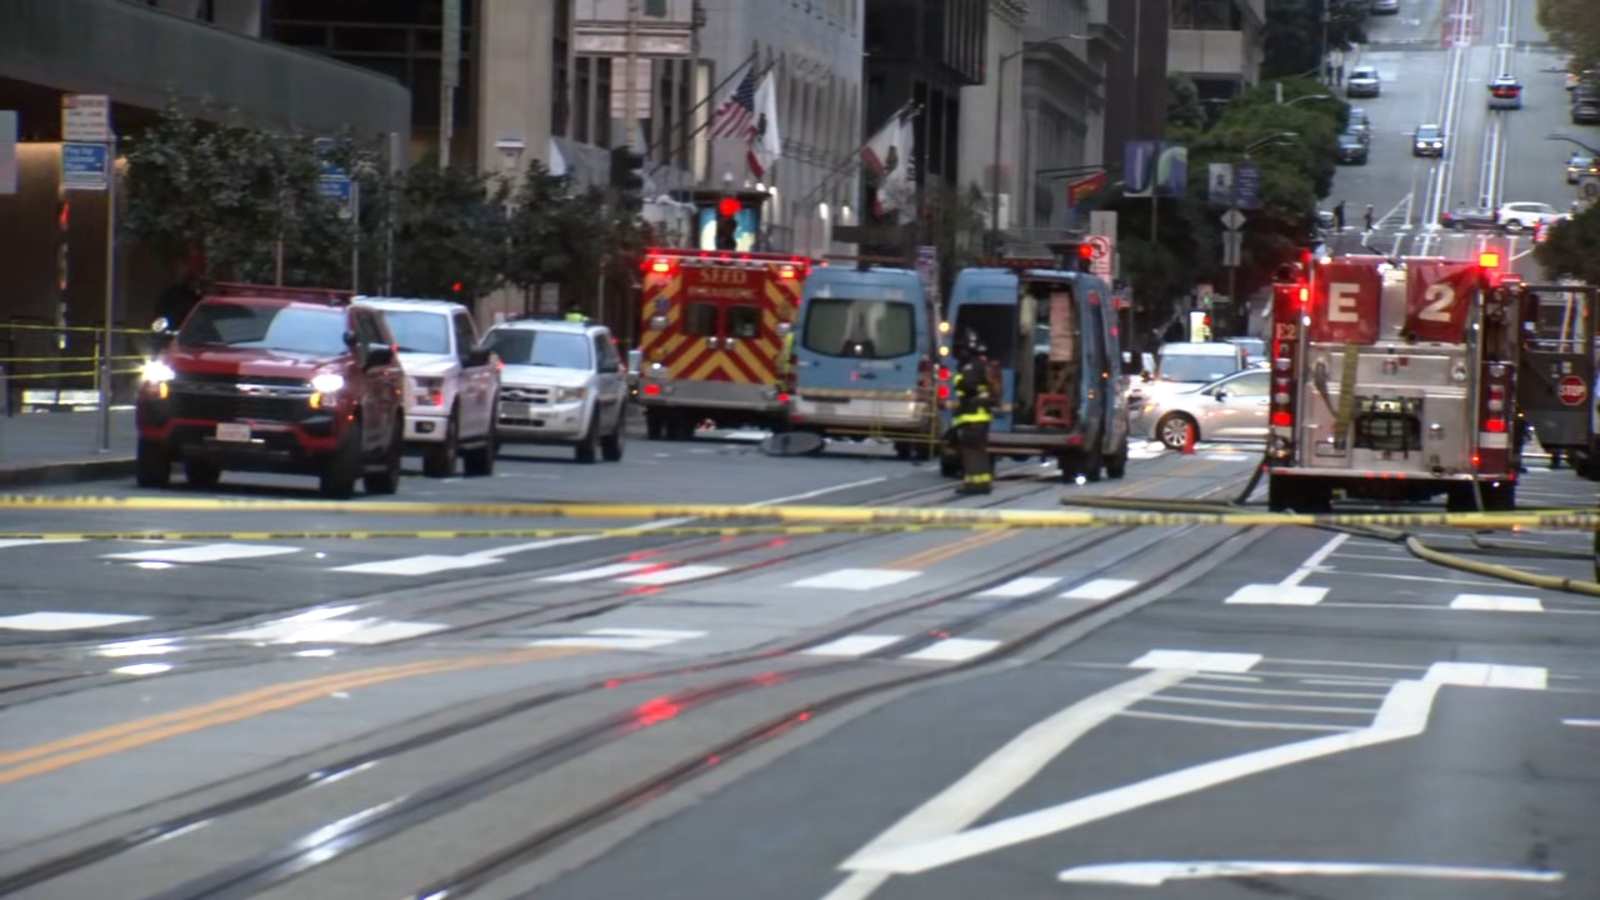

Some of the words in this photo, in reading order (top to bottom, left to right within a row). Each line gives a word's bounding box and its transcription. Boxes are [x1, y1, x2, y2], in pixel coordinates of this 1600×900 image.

[1328, 282, 1360, 322] E
[1418, 283, 1455, 322] 2
[1276, 323, 1296, 340] E2
[1559, 384, 1585, 396] STOP
